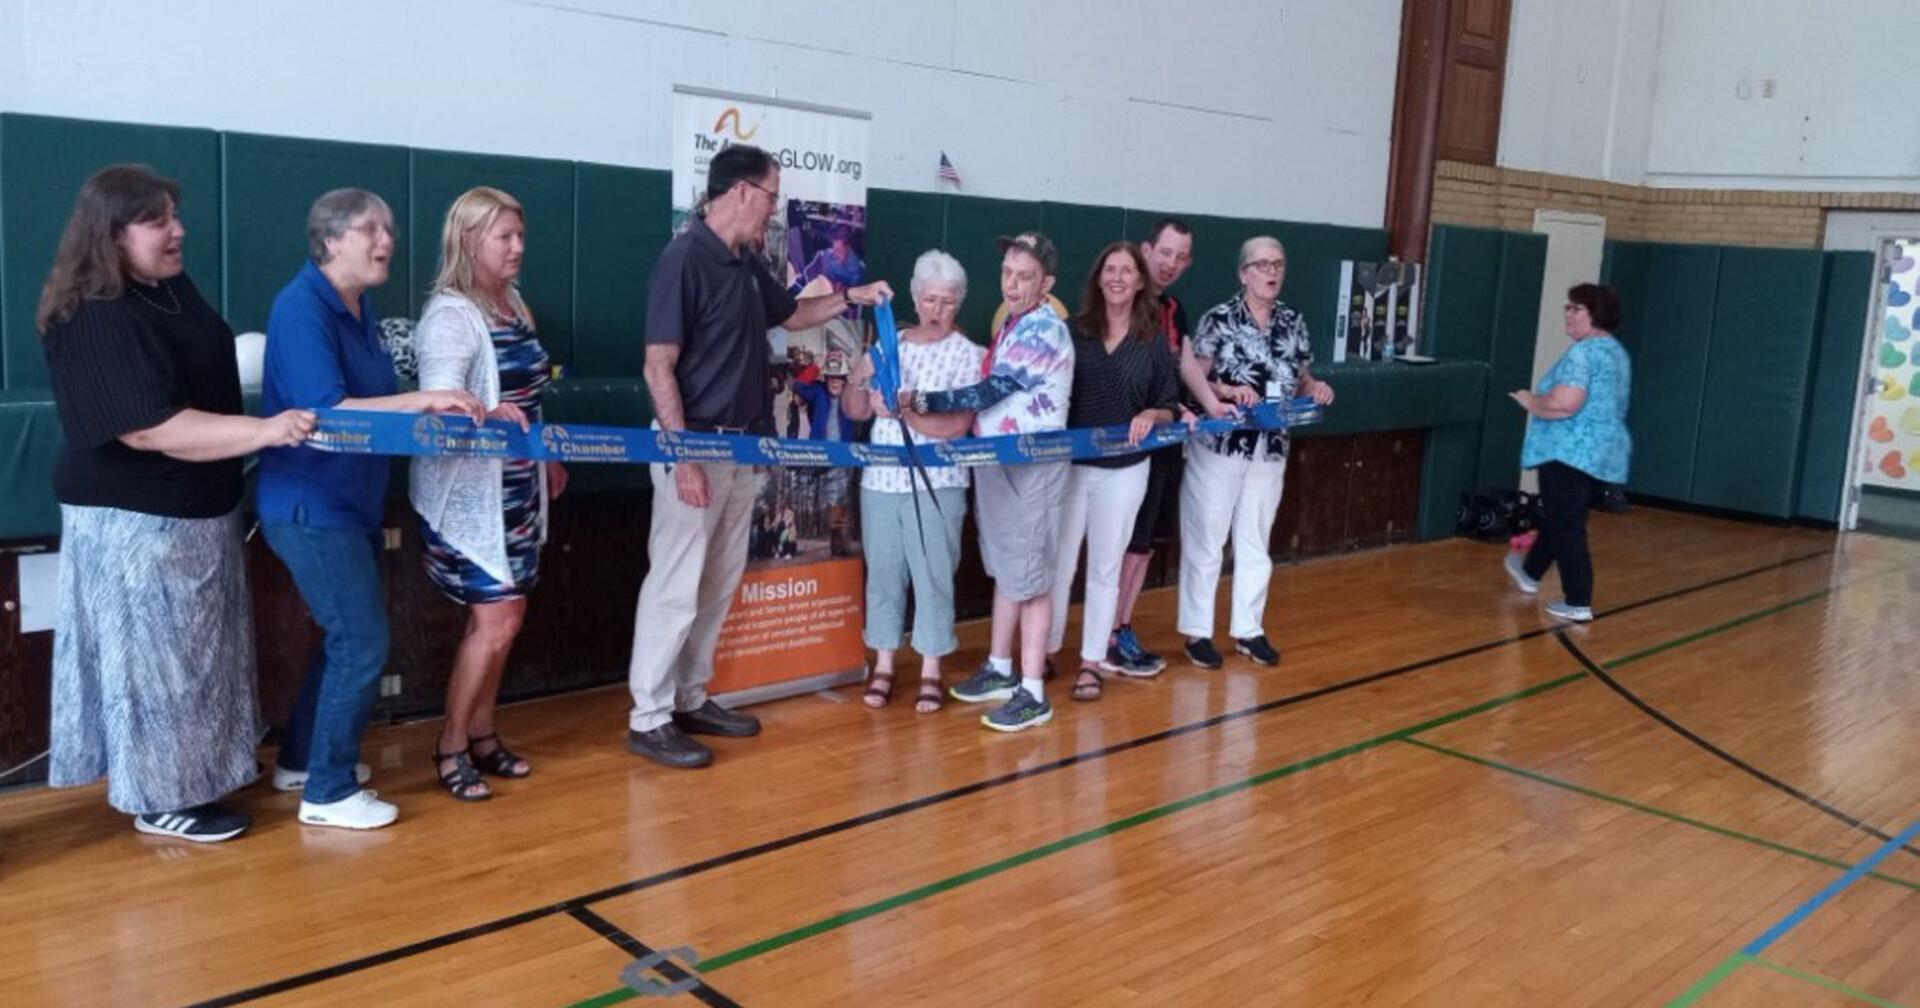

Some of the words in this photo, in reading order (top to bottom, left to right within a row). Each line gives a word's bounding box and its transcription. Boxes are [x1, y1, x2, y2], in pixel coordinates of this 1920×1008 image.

[693, 132, 718, 152] The
[433, 434, 509, 451] Chamber
[561, 441, 627, 456] Chamber
[674, 444, 733, 459] Chamber
[775, 449, 829, 461] Chamber
[950, 450, 997, 462] Chamber
[1031, 444, 1074, 457] Chamber
[741, 578, 818, 604] Mission
